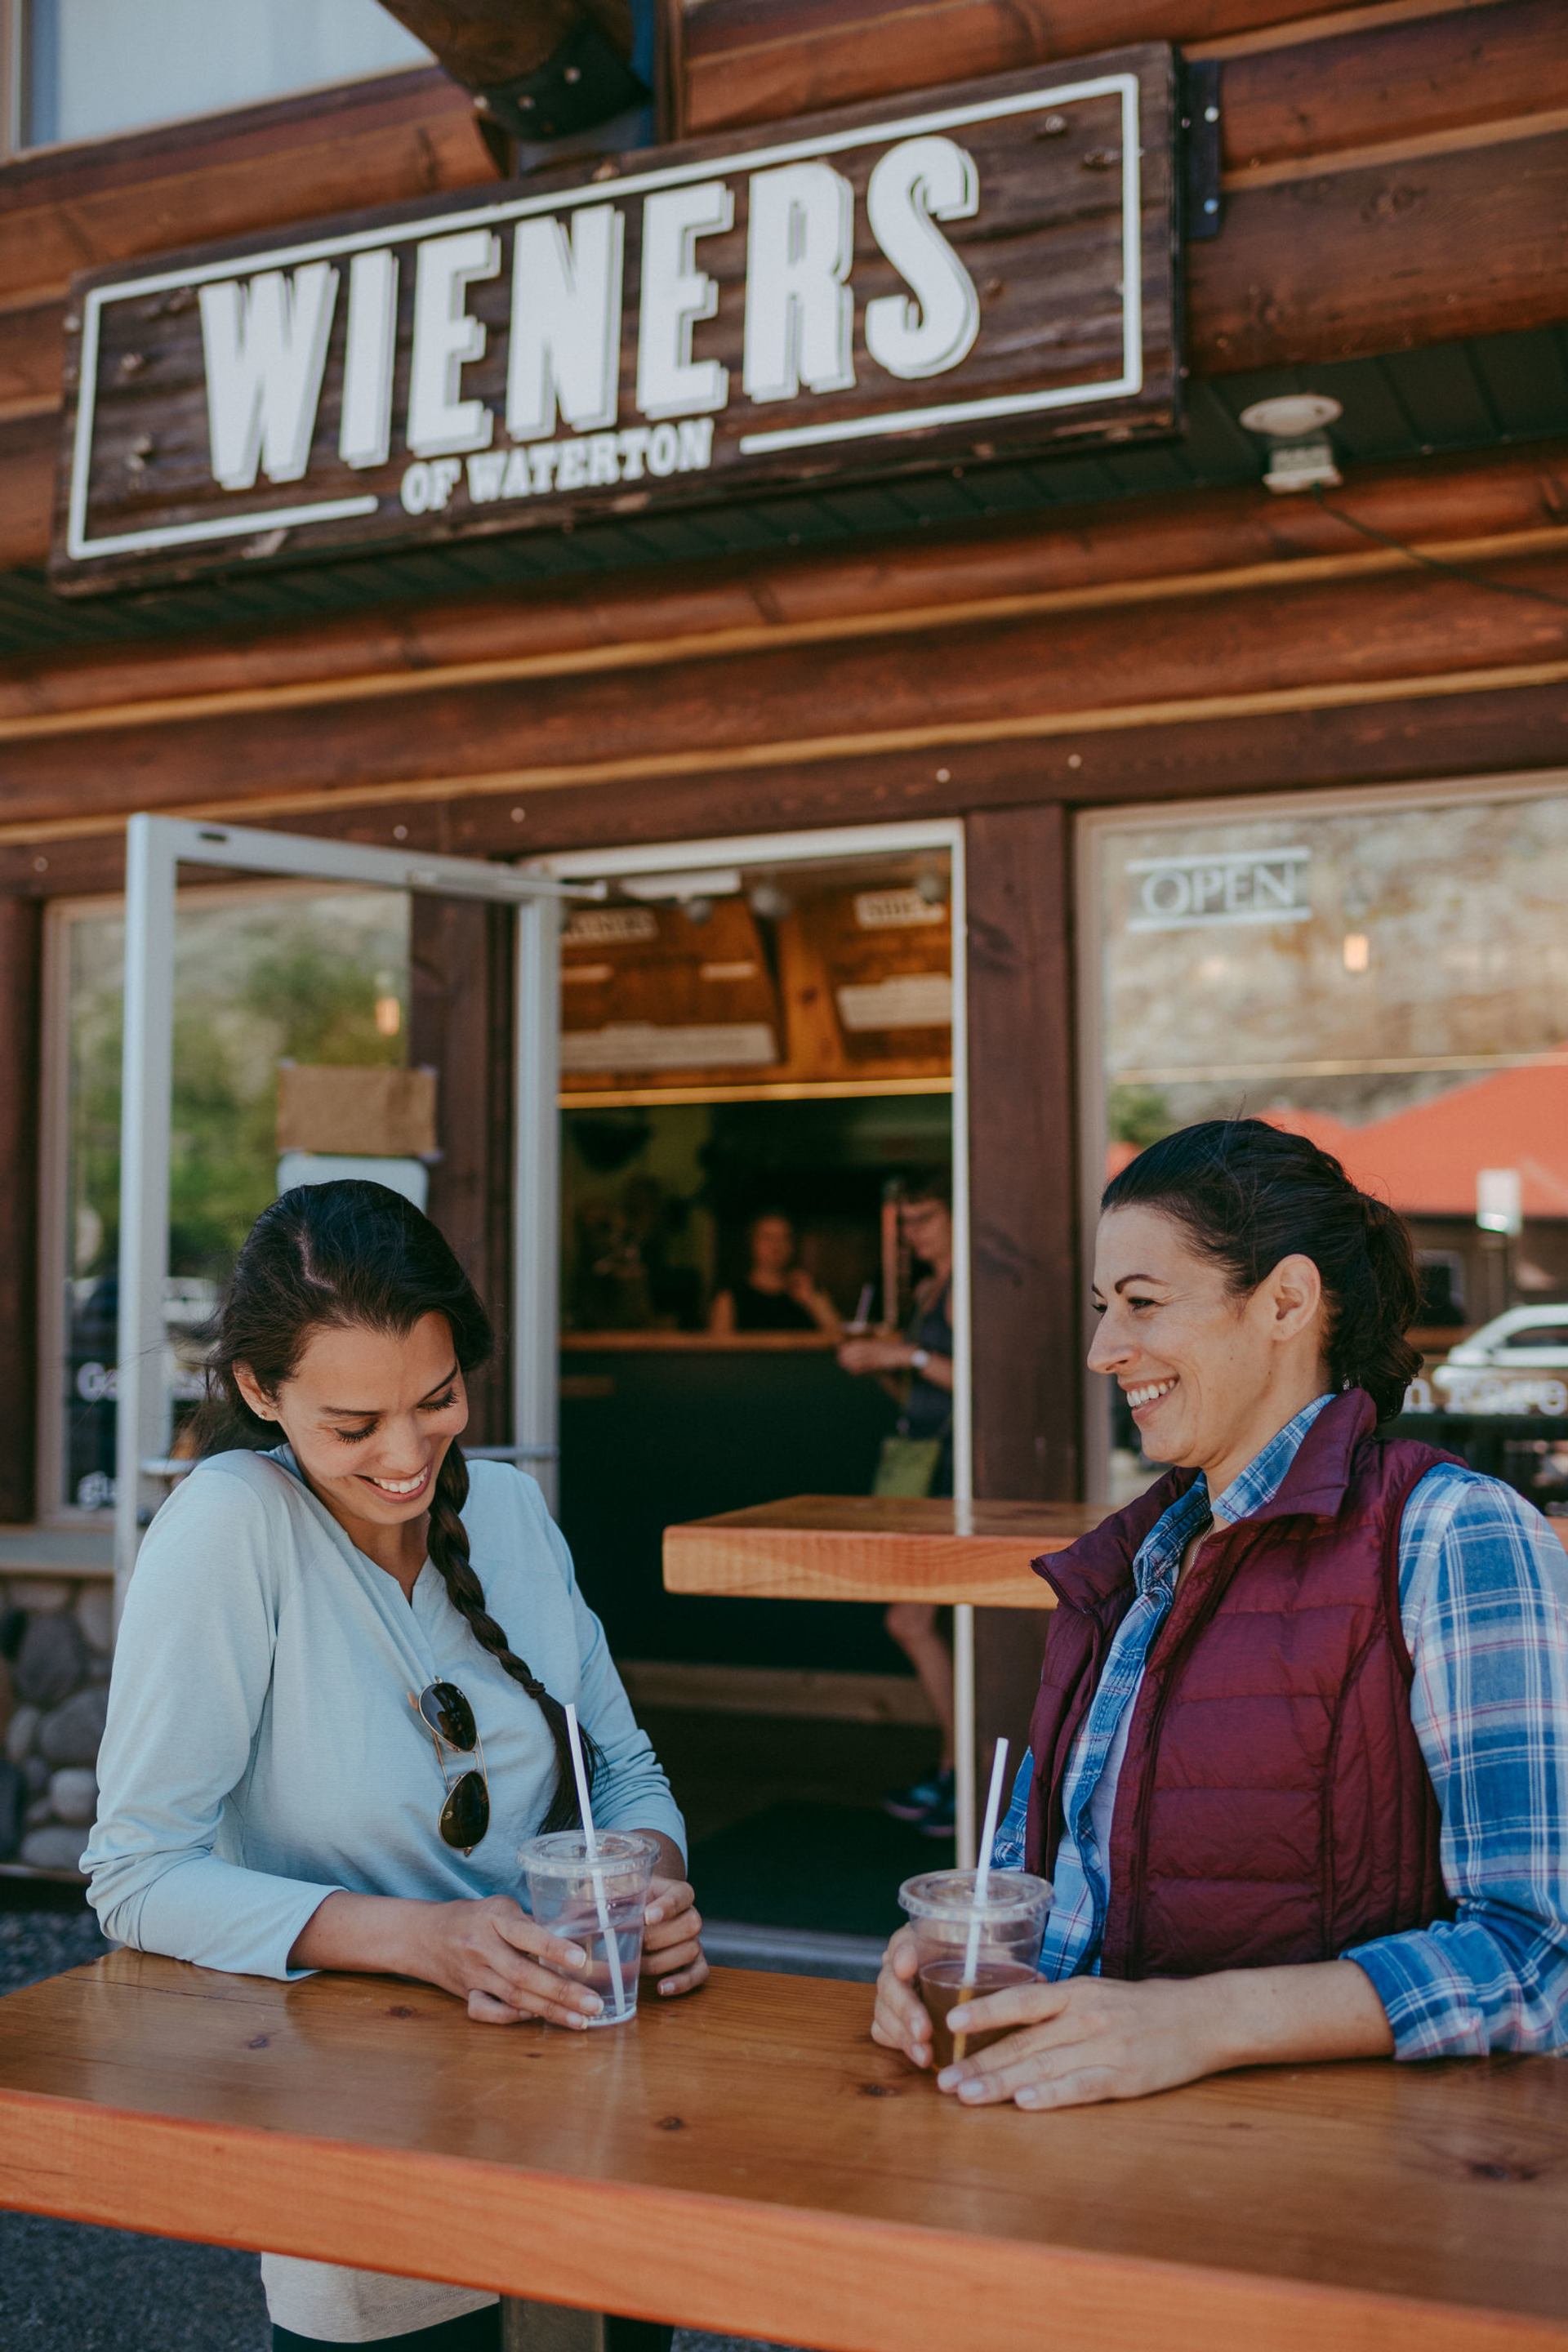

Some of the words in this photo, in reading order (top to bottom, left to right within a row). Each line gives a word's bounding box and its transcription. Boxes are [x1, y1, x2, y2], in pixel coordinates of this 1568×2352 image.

[198, 136, 979, 489] WIENERS
[401, 457, 461, 515] OF
[466, 417, 715, 504] WATERTON
[1141, 862, 1296, 916] OPEN
